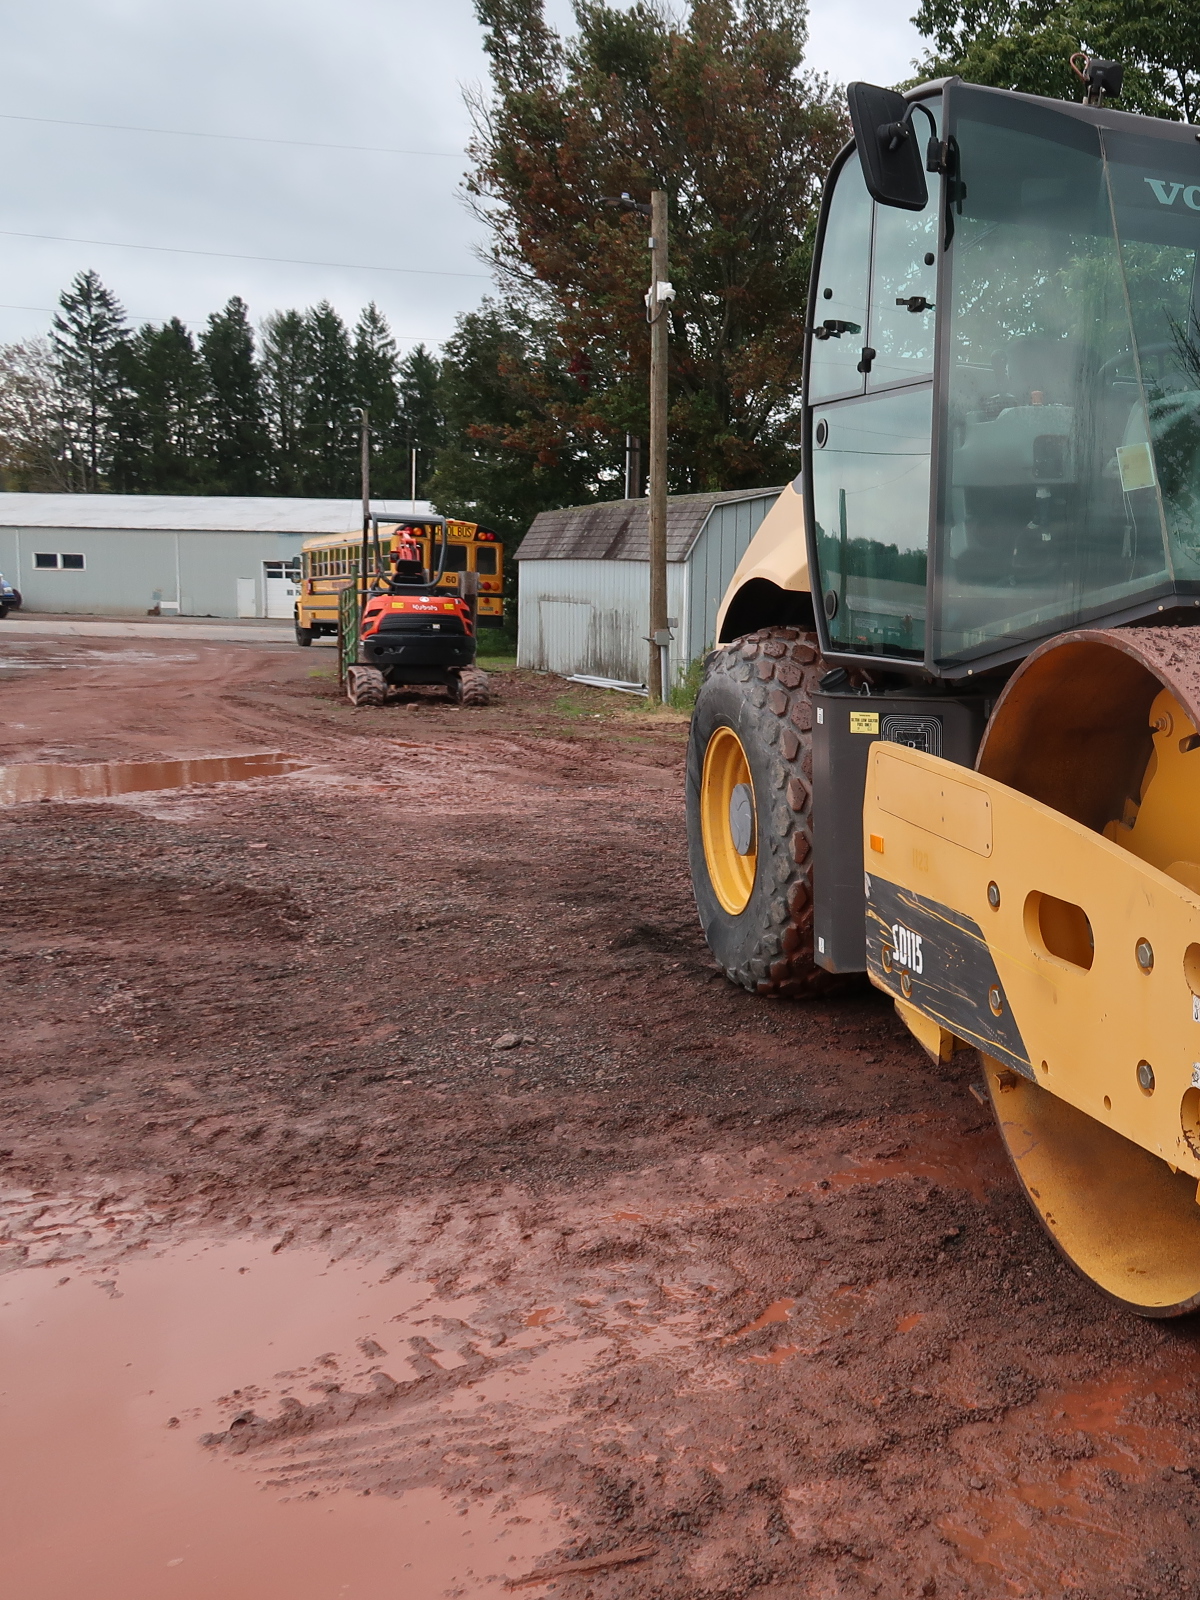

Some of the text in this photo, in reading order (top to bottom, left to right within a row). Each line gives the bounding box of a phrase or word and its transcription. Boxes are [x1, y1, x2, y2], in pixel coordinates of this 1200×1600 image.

[457, 526, 472, 538] BUS
[445, 575, 456, 584] 60
[892, 923, 923, 975] SD115
